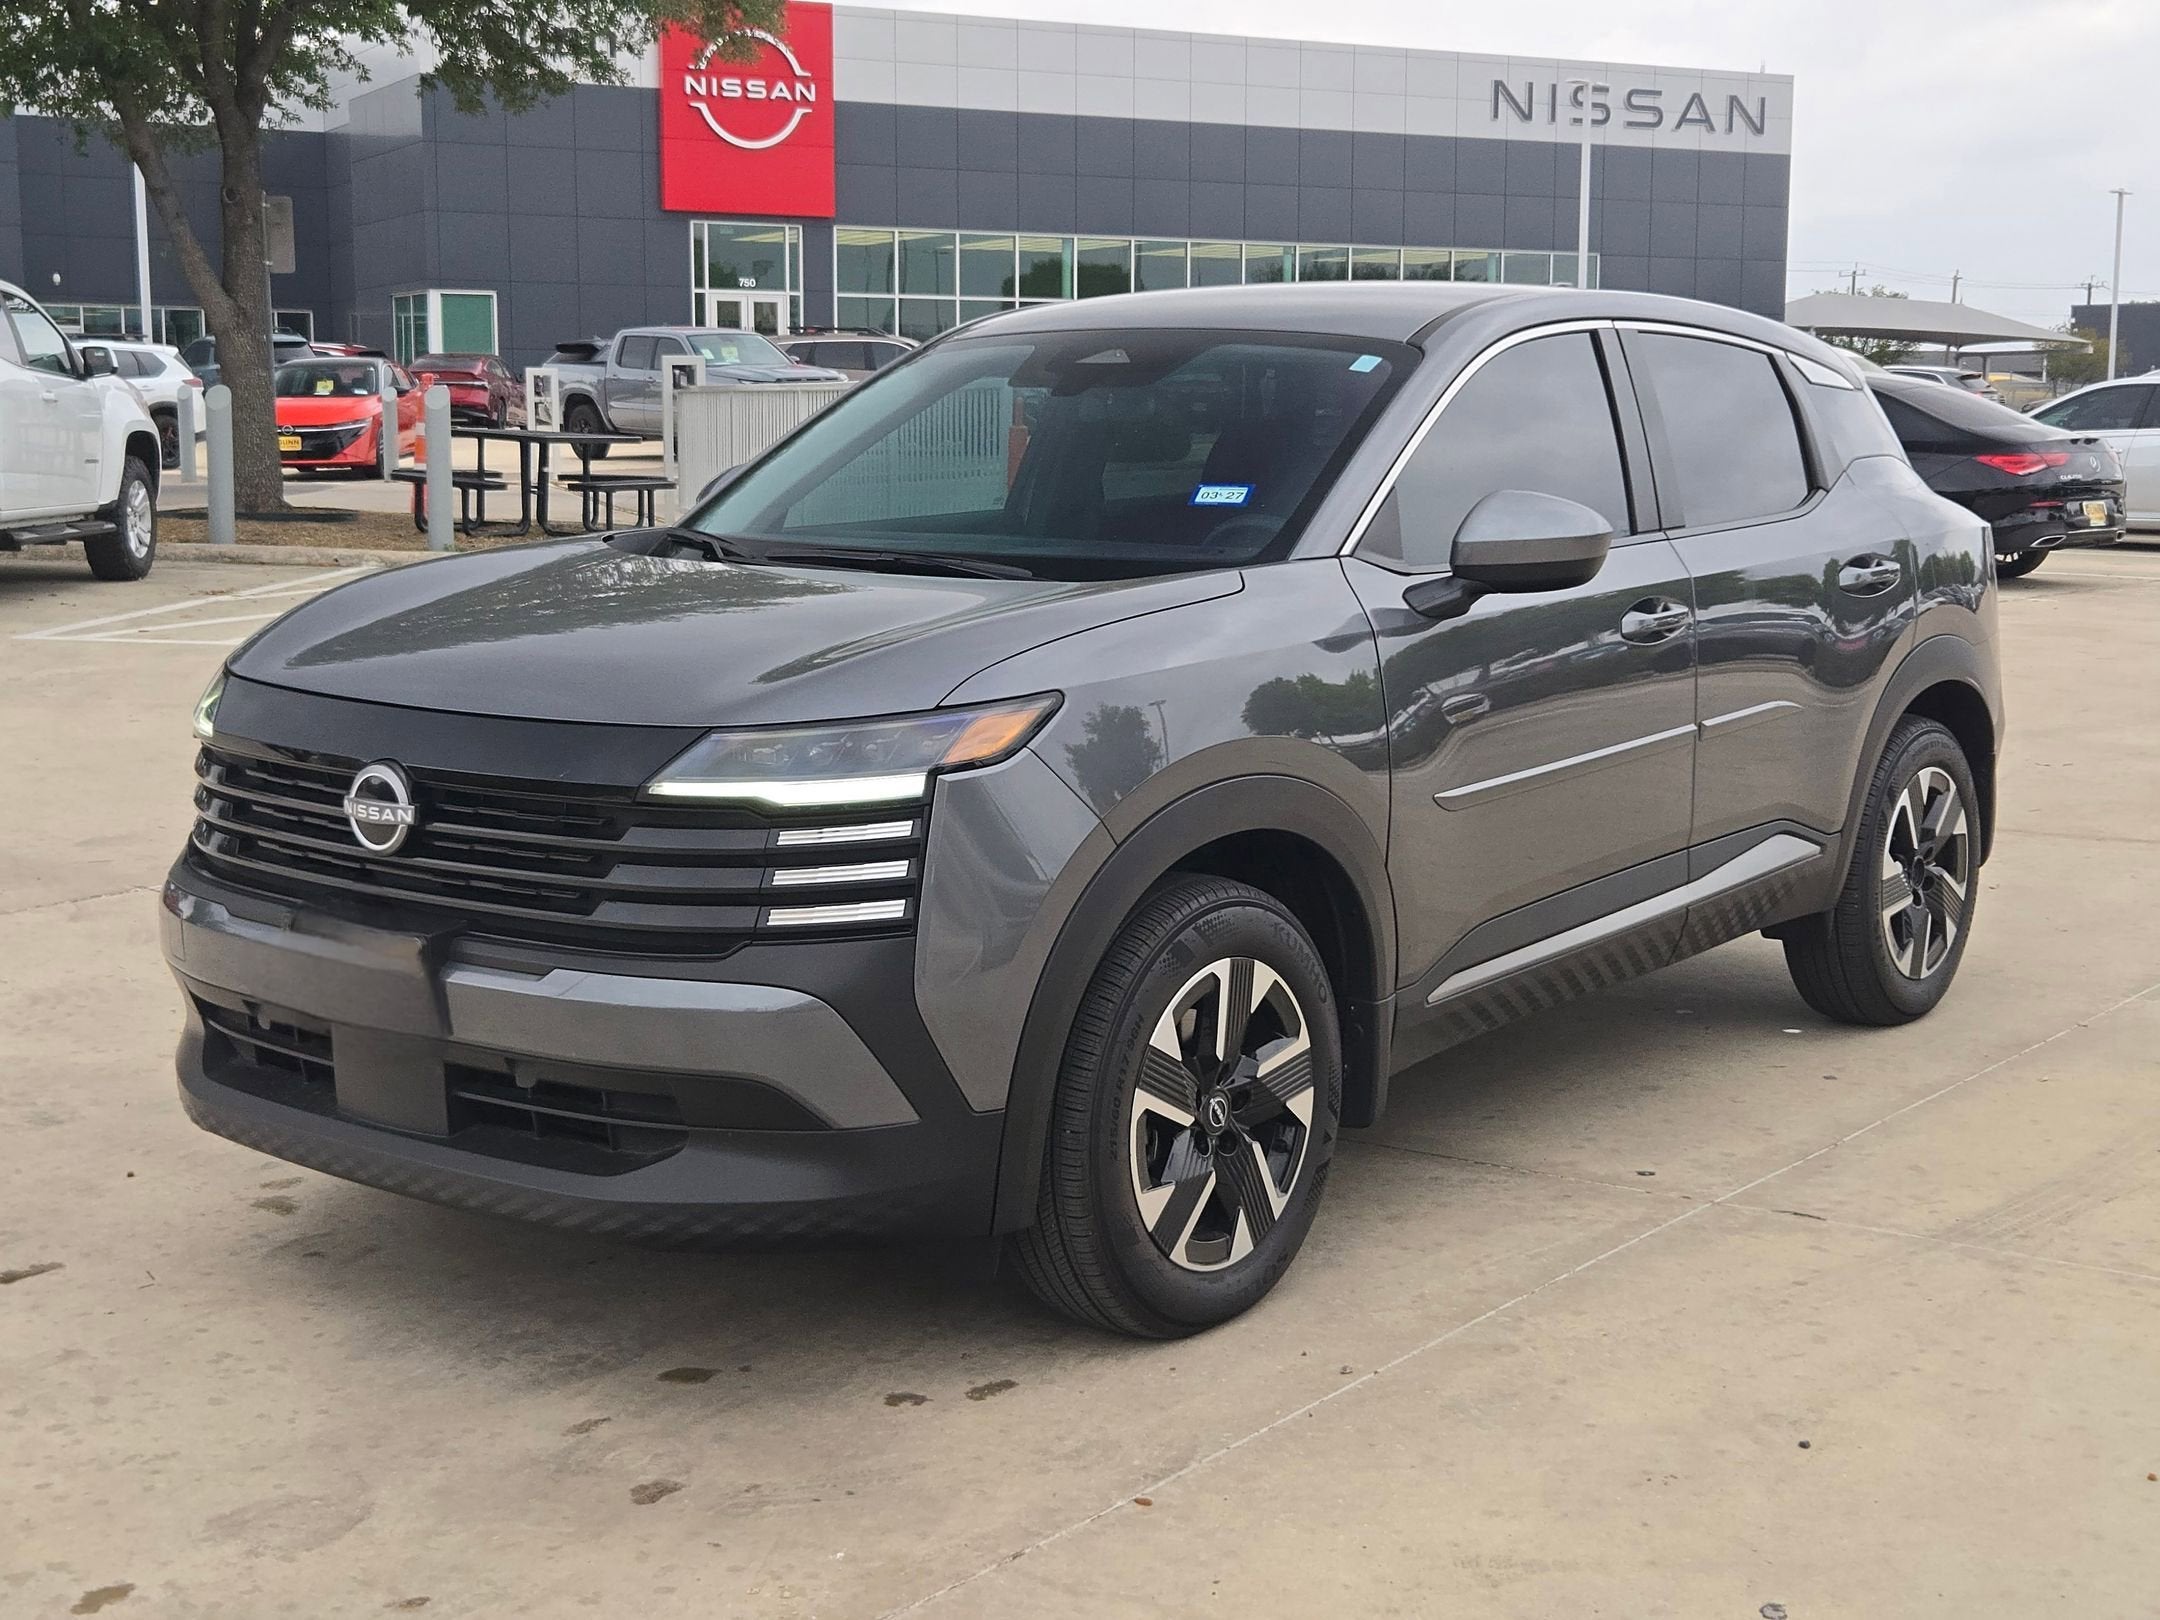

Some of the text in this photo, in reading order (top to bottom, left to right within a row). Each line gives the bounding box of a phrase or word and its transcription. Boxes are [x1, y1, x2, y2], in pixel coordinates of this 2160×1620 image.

[684, 75, 816, 102] NISSAN
[1490, 79, 1767, 137] NISSAN
[738, 278, 757, 288] 750
[1201, 491, 1245, 501] 03 27
[343, 799, 413, 823] NISSAN
